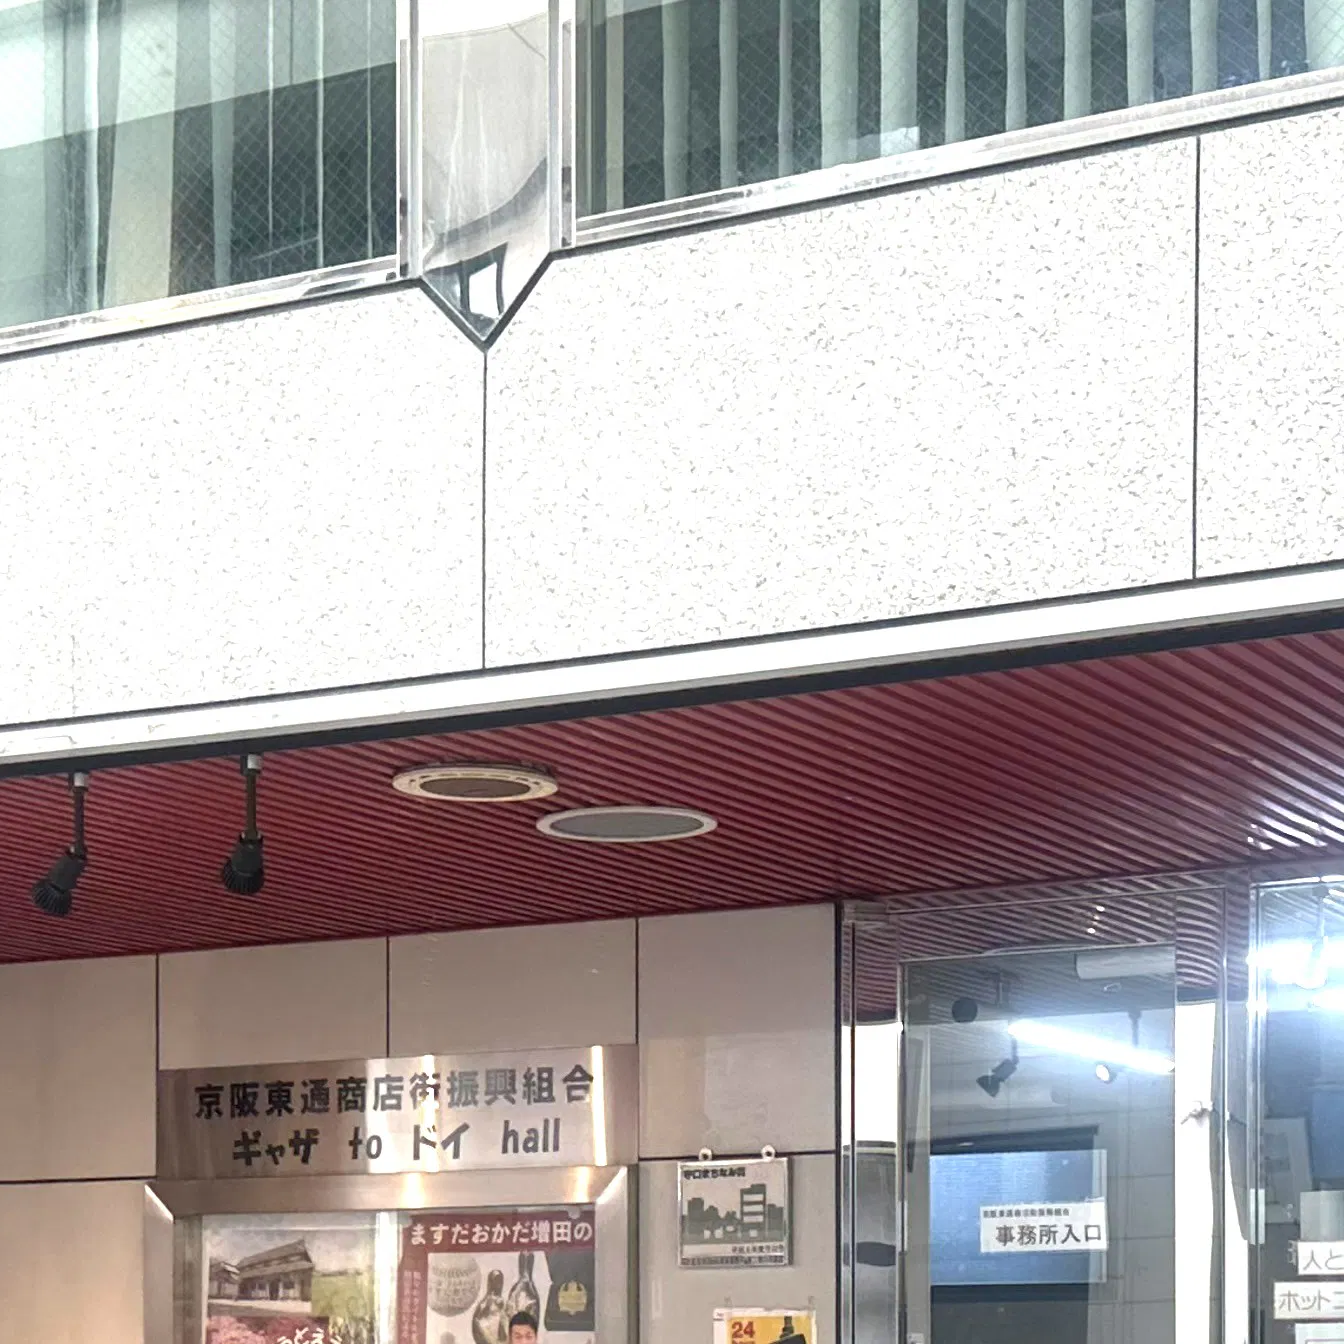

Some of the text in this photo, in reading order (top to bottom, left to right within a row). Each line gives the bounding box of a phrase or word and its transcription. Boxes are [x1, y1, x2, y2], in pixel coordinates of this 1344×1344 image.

[194, 1063, 595, 1119] 京阪東通商店街振興組合
[232, 1118, 561, 1166] ギャザ to ドイ hall
[410, 1220, 593, 1245] ますだおかだ増田の
[996, 1223, 1102, 1247] 事務所入口
[731, 1320, 756, 1339] 24
